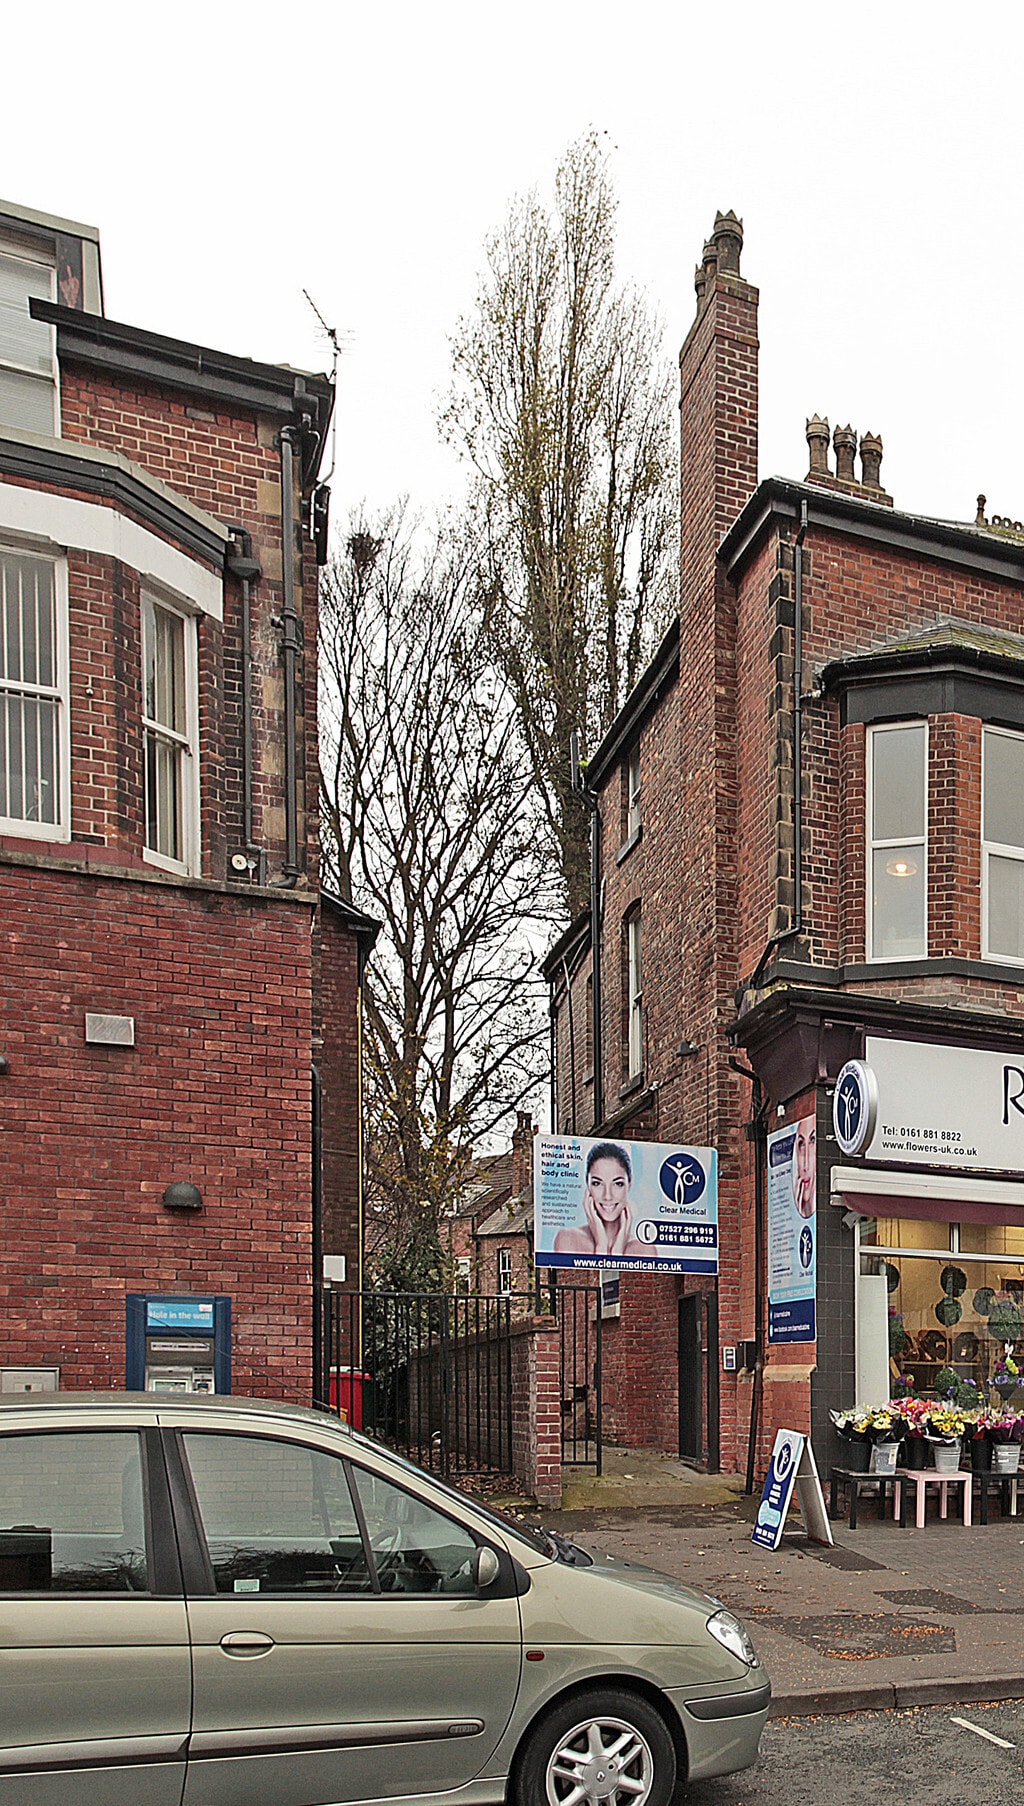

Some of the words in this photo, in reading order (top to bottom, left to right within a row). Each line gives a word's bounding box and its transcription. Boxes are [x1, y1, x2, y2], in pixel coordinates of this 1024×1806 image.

[881, 1125, 898, 1136] Tel:
[900, 1127, 920, 1138] 0161
[923, 1129, 938, 1139] 881
[941, 1131, 961, 1141] 8822
[541, 1142, 566, 1150] Honest
[881, 1141, 977, 1156] www.flowers-uk.co.uk
[566, 1153, 583, 1161] skin,
[541, 1169, 559, 1177] body
[659, 1205, 678, 1213] Clear
[680, 1207, 707, 1215] Medical
[659, 1224, 683, 1234] 07527
[659, 1233, 678, 1242] 0161
[695, 1235, 714, 1244] 5672
[573, 1258, 682, 1272] www.clearmedical.co.uk
[149, 1310, 168, 1319] Hole
[169, 1311, 177, 1319] in
[178, 1311, 191, 1319] the
[193, 1312, 211, 1320] wall
